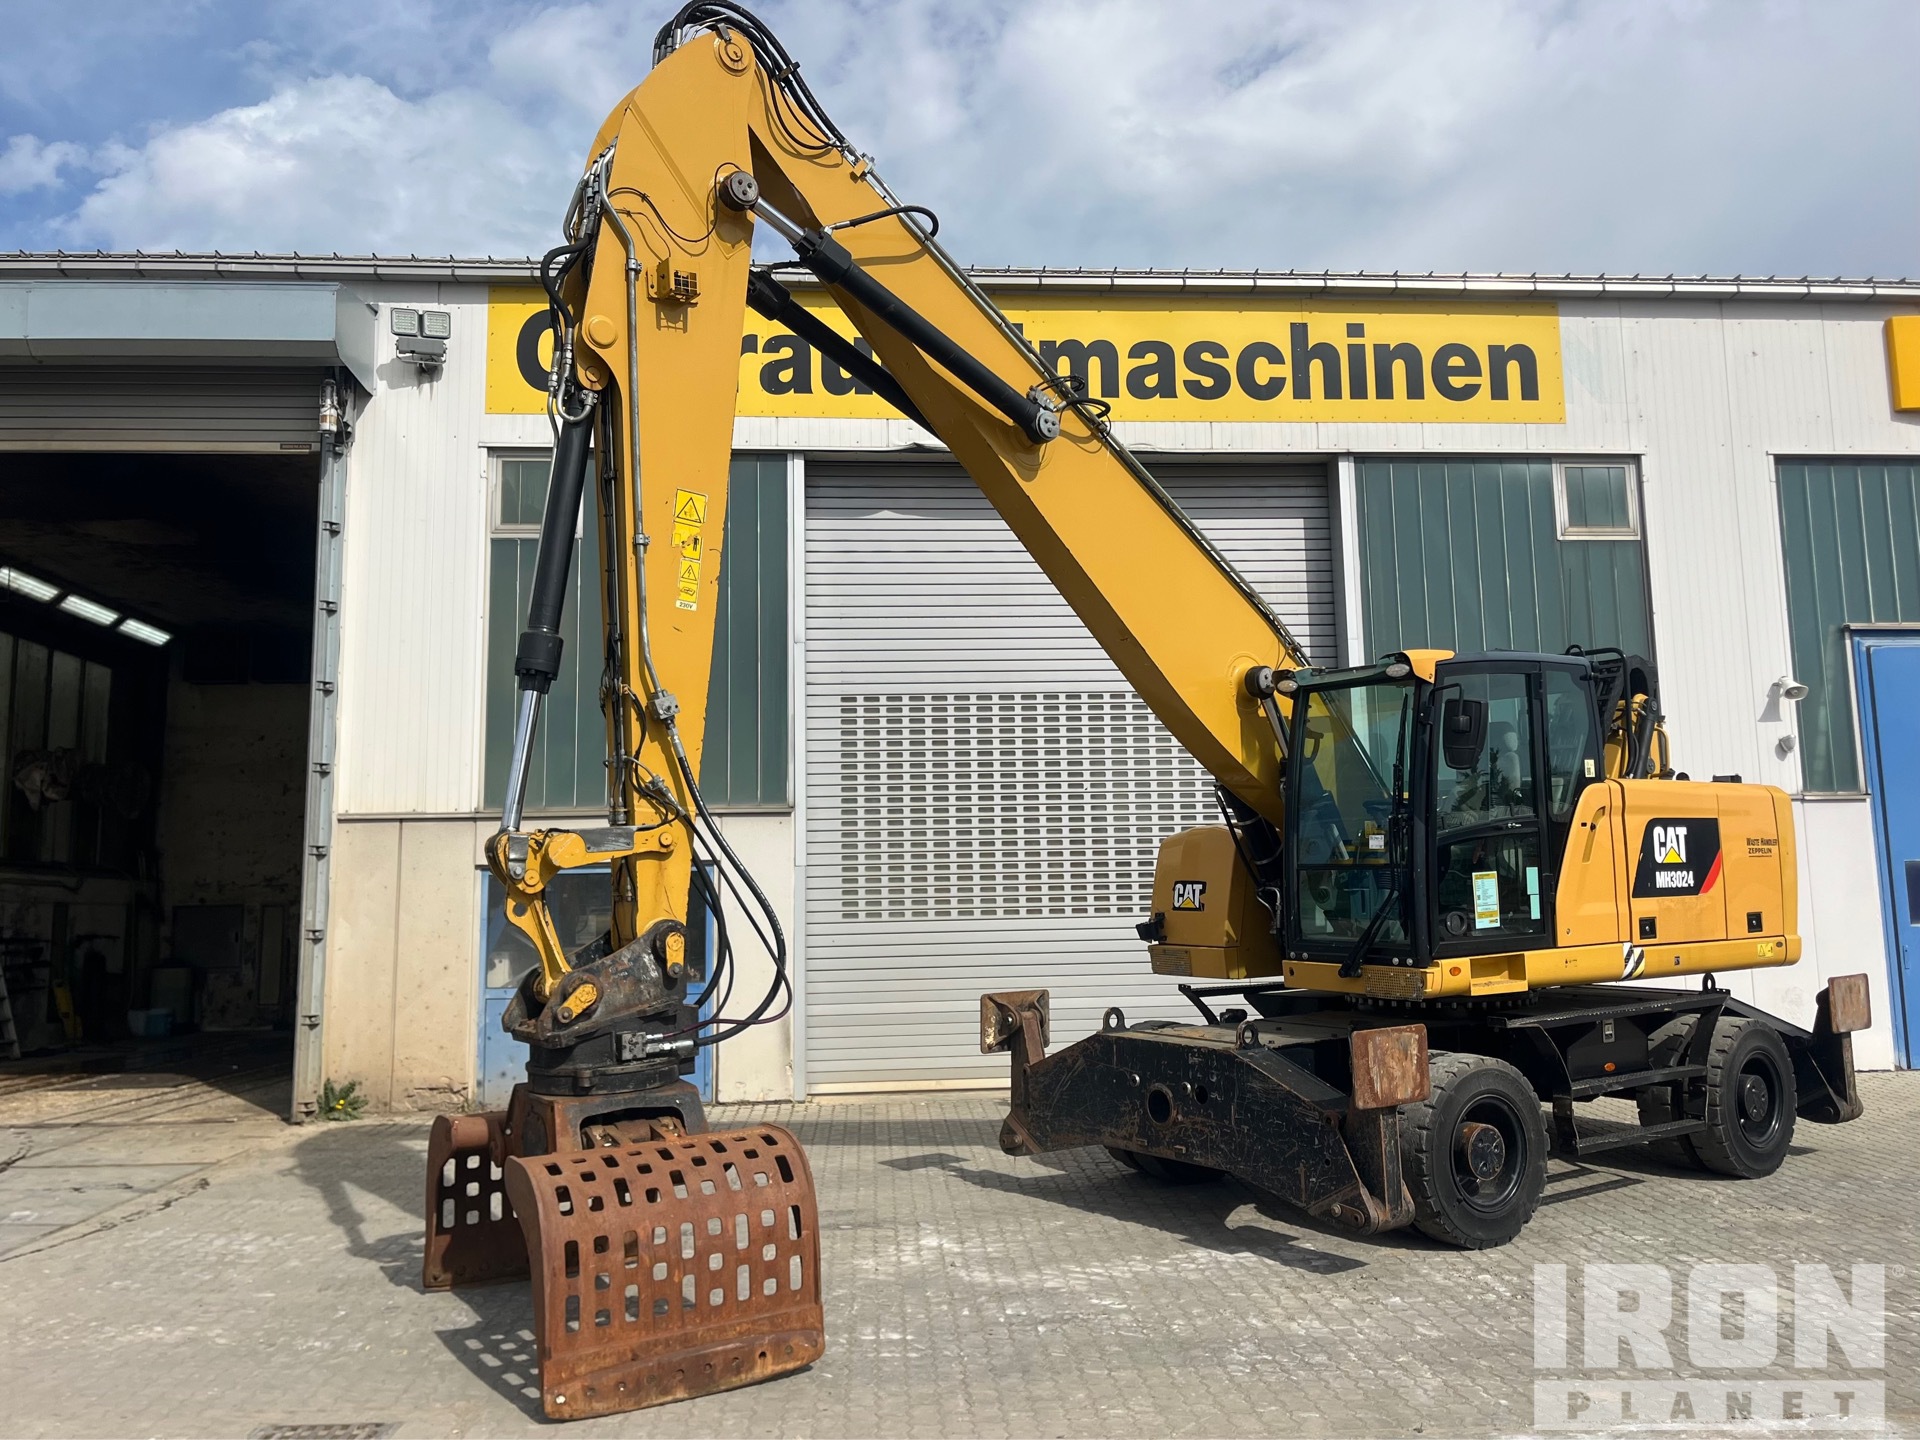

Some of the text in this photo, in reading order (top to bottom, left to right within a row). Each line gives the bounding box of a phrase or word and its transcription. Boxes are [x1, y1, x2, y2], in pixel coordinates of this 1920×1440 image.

[1653, 826, 1687, 864] CAT
[1748, 847, 1772, 855] ZEPPELIN
[1655, 870, 1694, 889] MH3024
[1174, 883, 1203, 909] CAT
